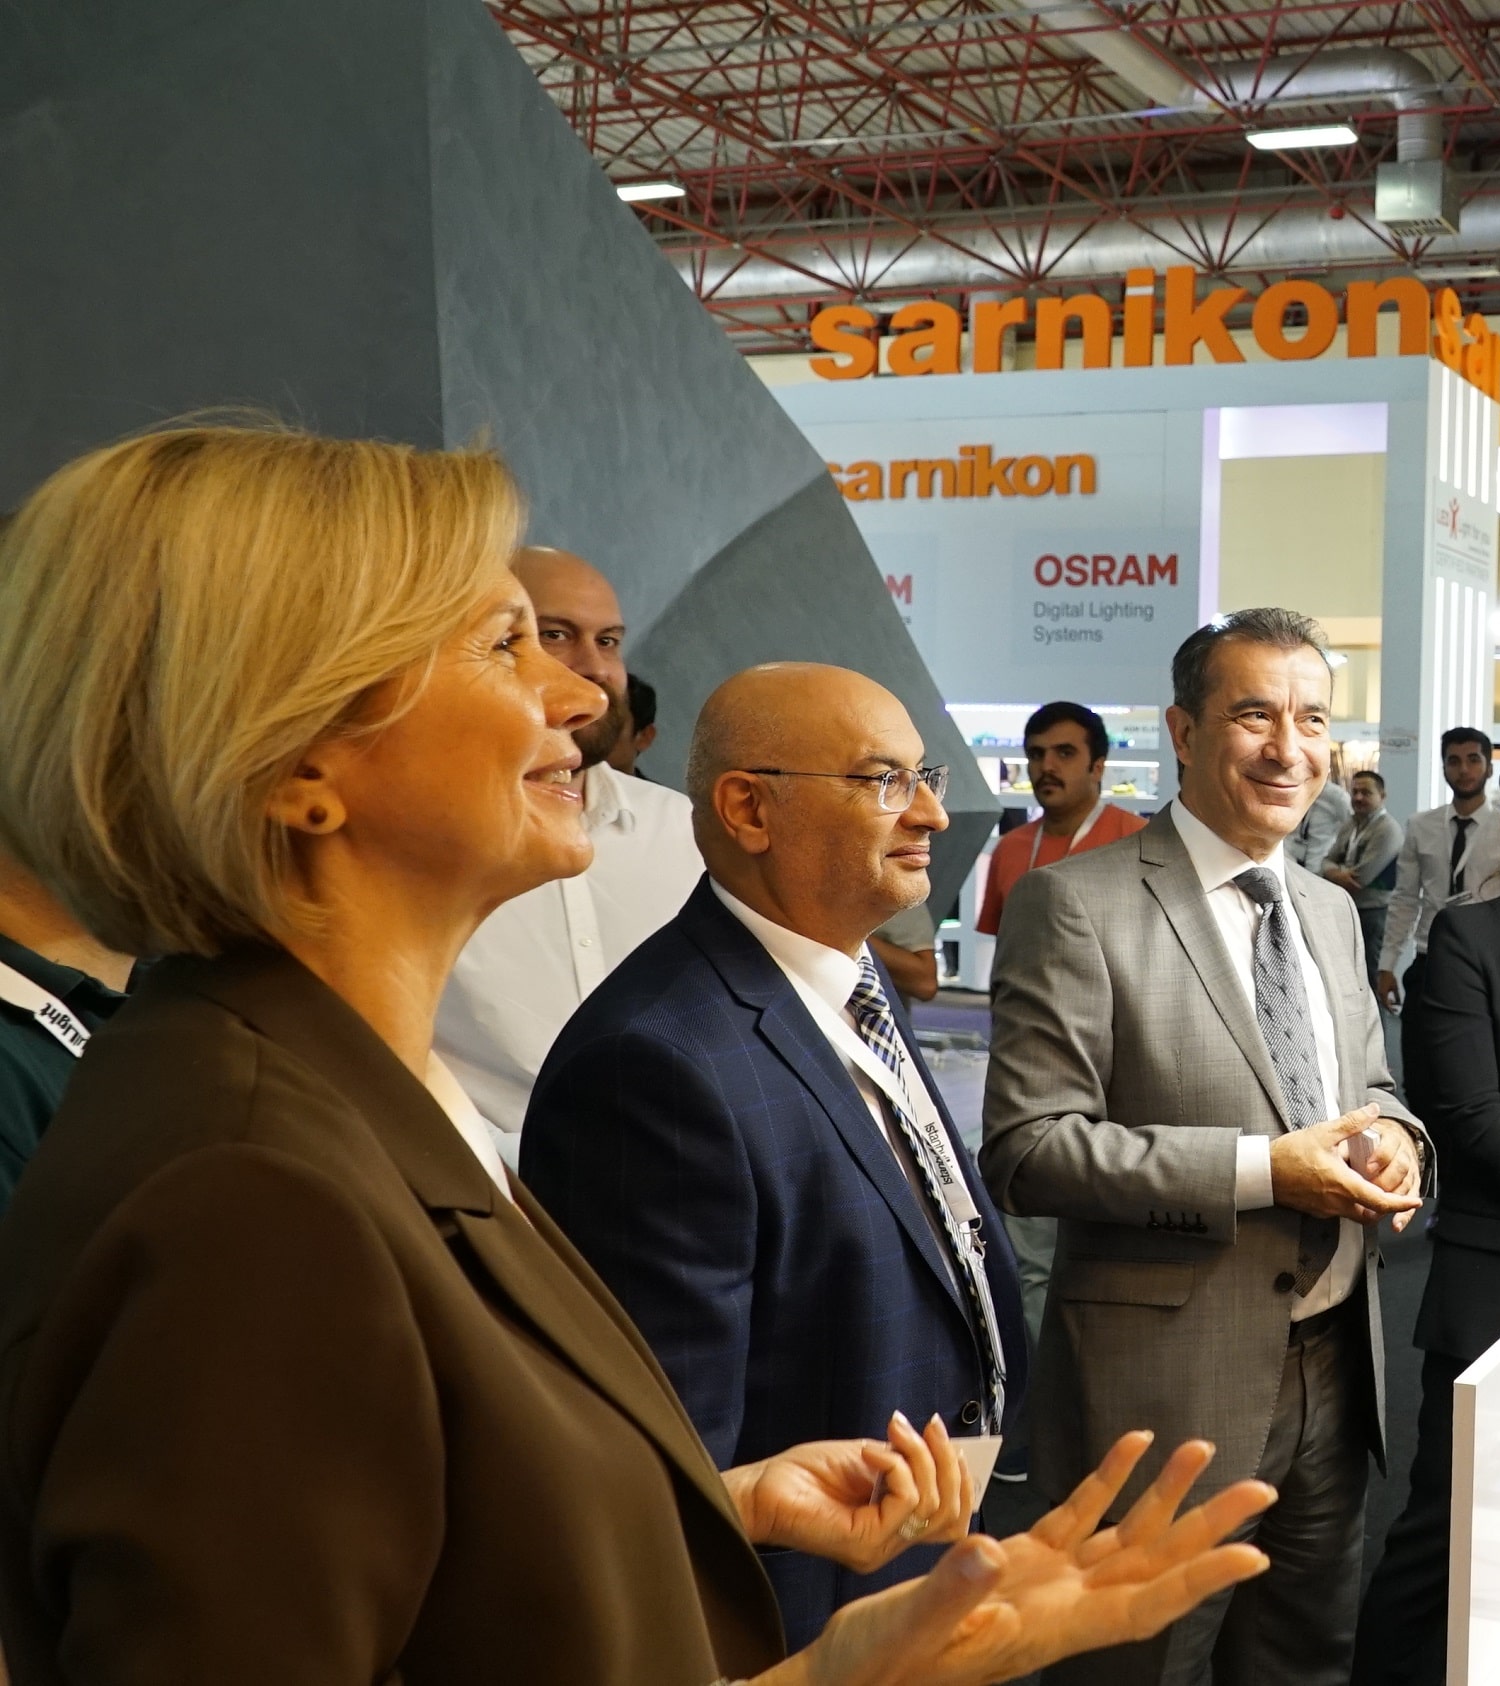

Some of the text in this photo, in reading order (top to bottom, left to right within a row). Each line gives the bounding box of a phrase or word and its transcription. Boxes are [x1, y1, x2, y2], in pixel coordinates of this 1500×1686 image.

[809, 266, 1431, 380] sarnikon
[1034, 553, 1178, 587] OSRAM
[1033, 601, 1154, 622] Digital Lighting
[1033, 625, 1103, 645] Systems
